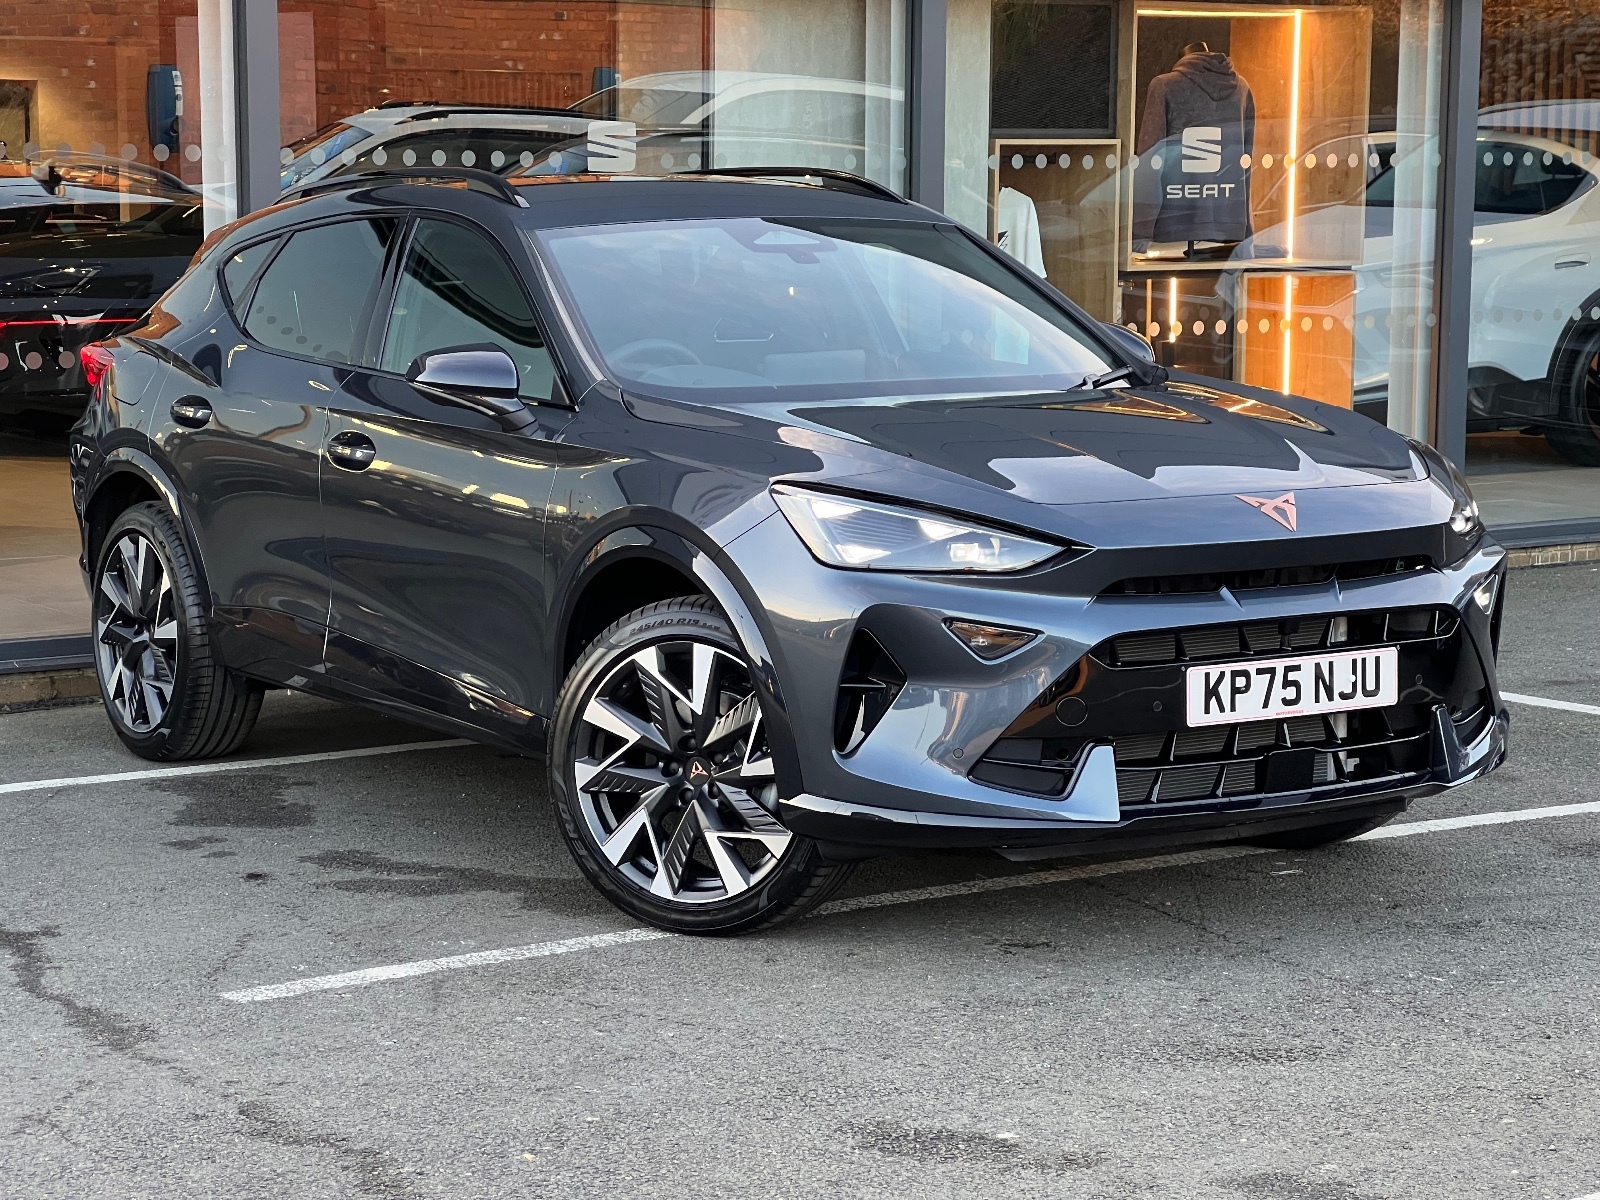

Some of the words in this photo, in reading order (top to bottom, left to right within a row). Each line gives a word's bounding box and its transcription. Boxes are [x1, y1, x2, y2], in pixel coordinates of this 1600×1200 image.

[1166, 183, 1235, 199] SEAT
[630, 618, 673, 635] 245/40
[677, 618, 699, 626] R19
[1204, 664, 1301, 714] KP75
[1314, 655, 1381, 704] NJU
[557, 801, 600, 873] ZERO
